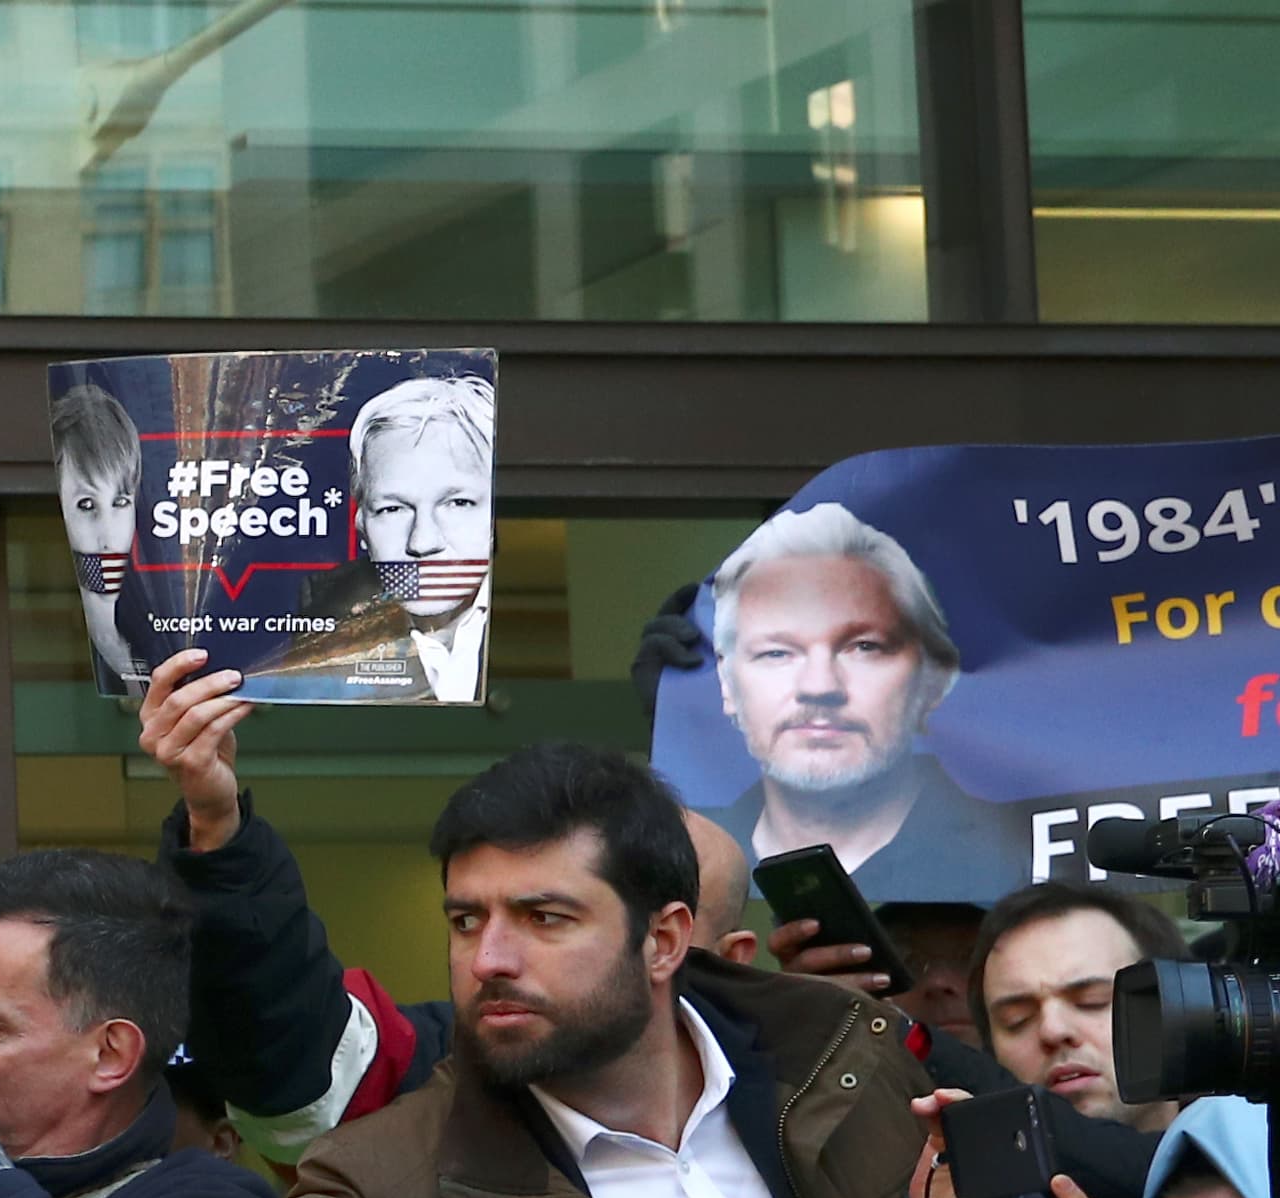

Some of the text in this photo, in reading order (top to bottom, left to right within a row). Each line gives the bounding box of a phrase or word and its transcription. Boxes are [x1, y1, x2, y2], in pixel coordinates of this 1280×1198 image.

[168, 460, 309, 498] #Free
[1013, 482, 1276, 563] '1984'
[219, 617, 259, 632] war
[265, 614, 336, 632] crimes
[1110, 590, 1235, 645] For
